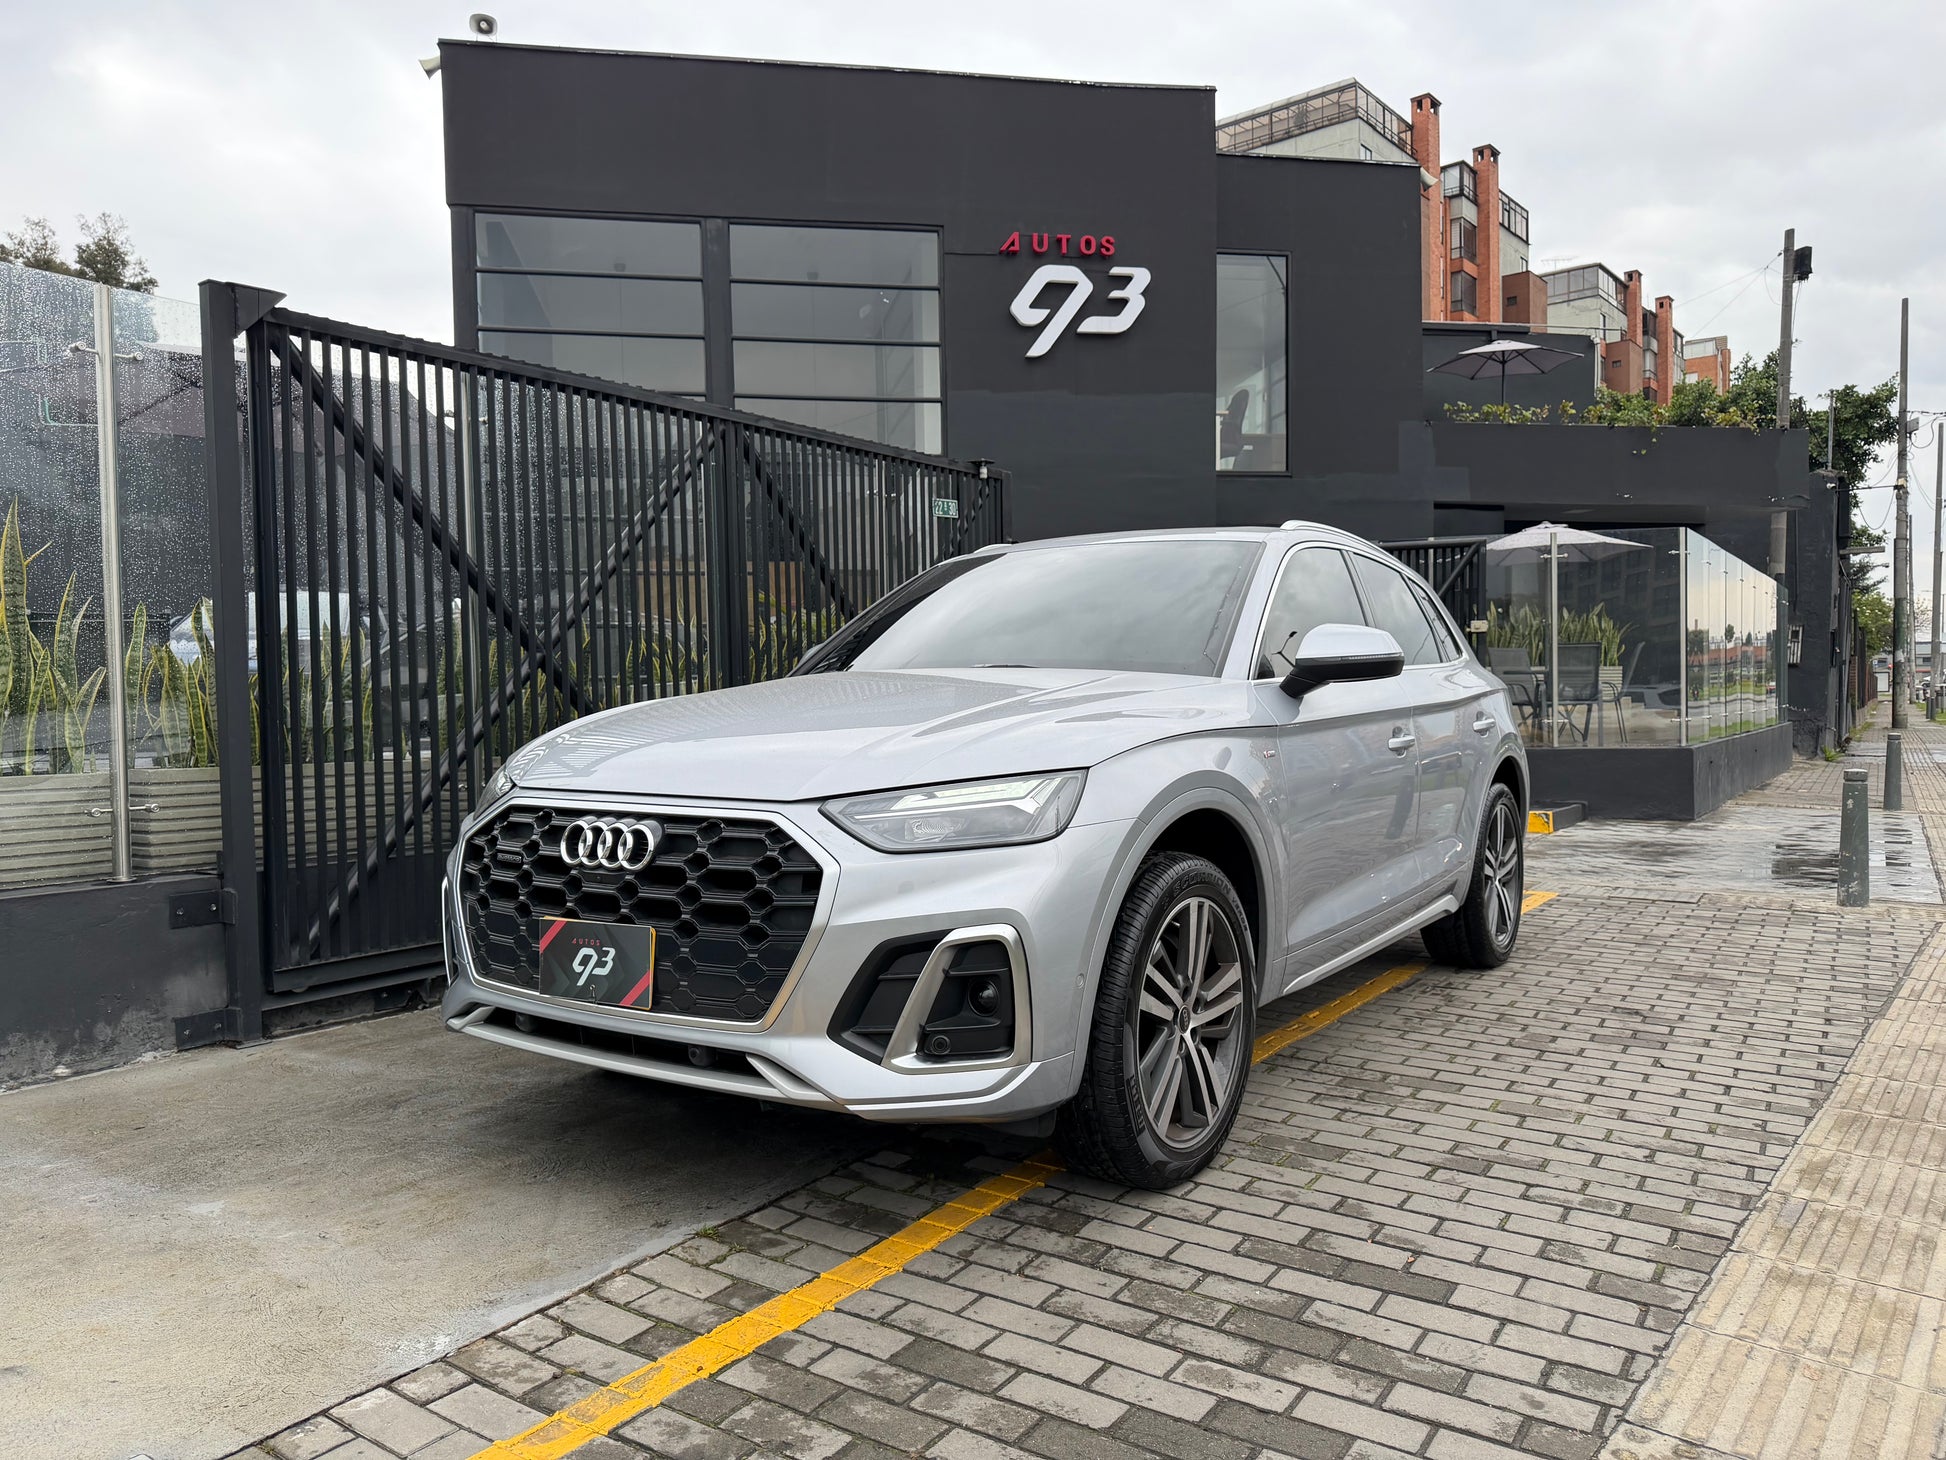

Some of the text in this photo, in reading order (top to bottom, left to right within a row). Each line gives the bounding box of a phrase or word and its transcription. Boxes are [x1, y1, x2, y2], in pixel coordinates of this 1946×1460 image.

[999, 231, 1116, 257] AUTOS
[1009, 264, 1152, 358] 93
[571, 937, 601, 946] AUTOS
[572, 946, 616, 986] 93
